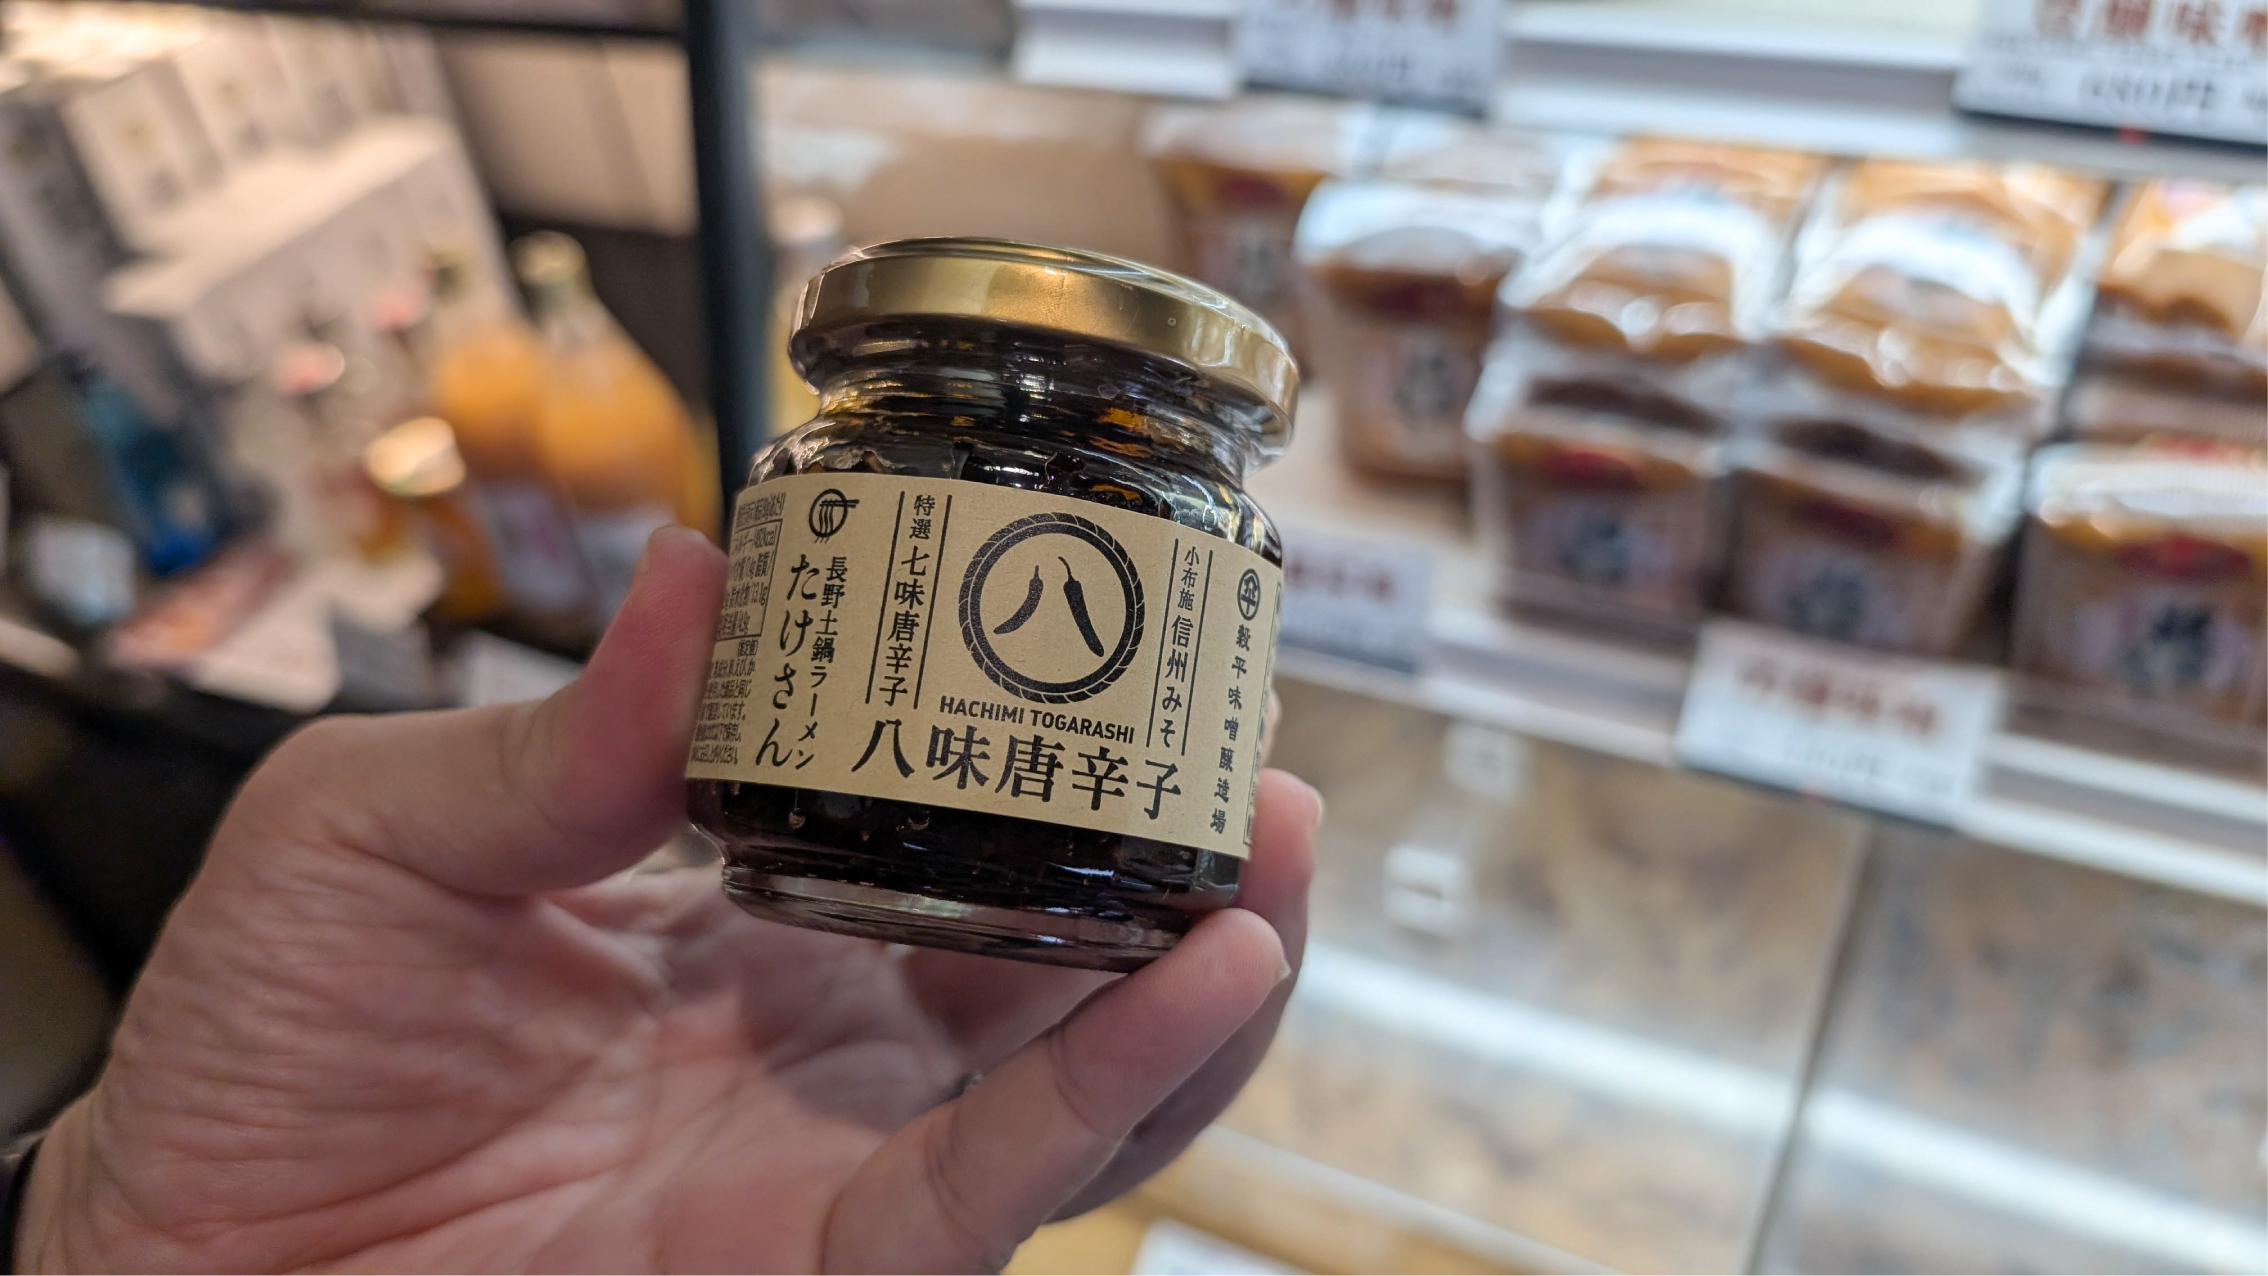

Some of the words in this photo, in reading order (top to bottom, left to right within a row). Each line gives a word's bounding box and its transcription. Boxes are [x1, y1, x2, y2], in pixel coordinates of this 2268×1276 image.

[756, 553, 821, 767] たけさん
[795, 556, 849, 770] 長野土鍋ラーメン
[939, 695, 1024, 724] HACHIMI
[1030, 709, 1135, 744] TOGARASHI
[851, 718, 1182, 820] 八味唐辛子
